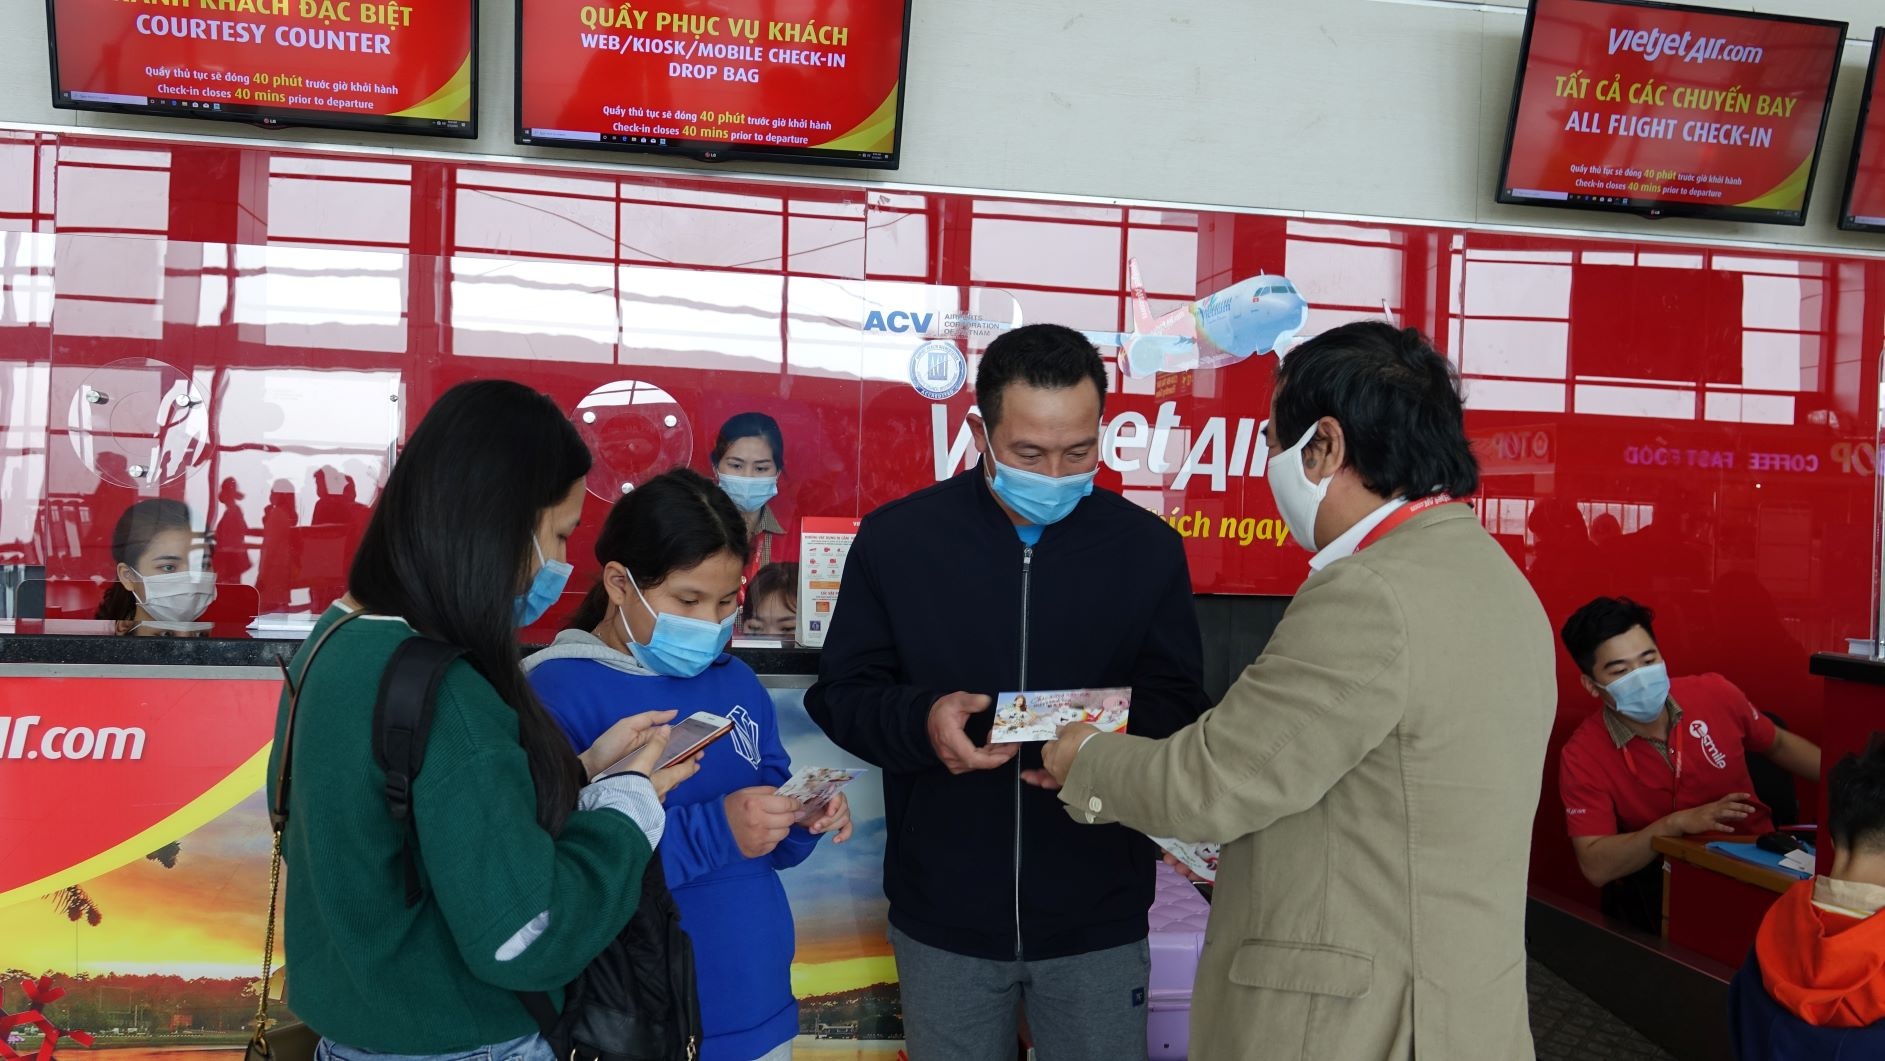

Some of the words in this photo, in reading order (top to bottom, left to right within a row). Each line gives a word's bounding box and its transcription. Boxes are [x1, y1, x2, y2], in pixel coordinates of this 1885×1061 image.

[298, 0, 351, 26] ĐẶC
[360, 1, 413, 31] BIỆT
[580, 2, 649, 31] QUẦY
[656, 12, 721, 40] PHỤC
[727, 17, 760, 44] VỤ
[768, 19, 848, 46] KHÁCH
[136, 14, 266, 44] COURTESY
[275, 26, 391, 55] COUNTER
[581, 33, 763, 62] WEB/KIOSK/MOBILE
[768, 48, 847, 68] CHECK-IN
[224, 73, 250, 85] đóng
[253, 73, 269, 84] 40
[272, 74, 303, 88] phút
[374, 84, 399, 95] hành
[668, 62, 718, 80] DROP
[723, 66, 760, 83] BAG
[157, 84, 200, 97] Check-in
[202, 86, 232, 98] closes
[234, 88, 251, 101] 40
[254, 89, 286, 102] mins
[288, 94, 311, 105] prior
[314, 97, 324, 105] to
[326, 96, 374, 110] departure
[1555, 69, 1591, 99] TẤT
[1596, 73, 1621, 102] CẢ
[1628, 78, 1668, 106] CÁC
[1672, 84, 1751, 114] CHUYẾN
[1756, 95, 1798, 118] BAY
[674, 110, 698, 122] đóng
[700, 111, 715, 122] 40
[717, 112, 746, 125] phút
[747, 115, 770, 127] trước
[809, 120, 832, 131] hành
[1564, 110, 1601, 133] ALL
[1608, 114, 1677, 139] FLIGHT
[1682, 121, 1772, 148] CHECK-IN
[612, 122, 651, 133] Check-in
[652, 124, 680, 135] closes
[682, 125, 697, 137] 40
[700, 127, 729, 139] mins
[730, 131, 752, 142] prior
[754, 133, 764, 141] to
[765, 133, 809, 144] departure
[1643, 168, 1655, 178] 40
[1656, 169, 1676, 181] phút
[1575, 179, 1604, 189] Check-in
[1606, 181, 1626, 191] closes
[1627, 182, 1639, 192] 40
[1640, 182, 1661, 193] mins
[1662, 185, 1679, 196] prior
[1680, 187, 1688, 195] to
[1689, 187, 1722, 199] departure
[864, 310, 933, 333] ACV
[944, 321, 1000, 329] CORORATION
[1145, 506, 1210, 538] ích
[1219, 516, 1290, 547] ngay
